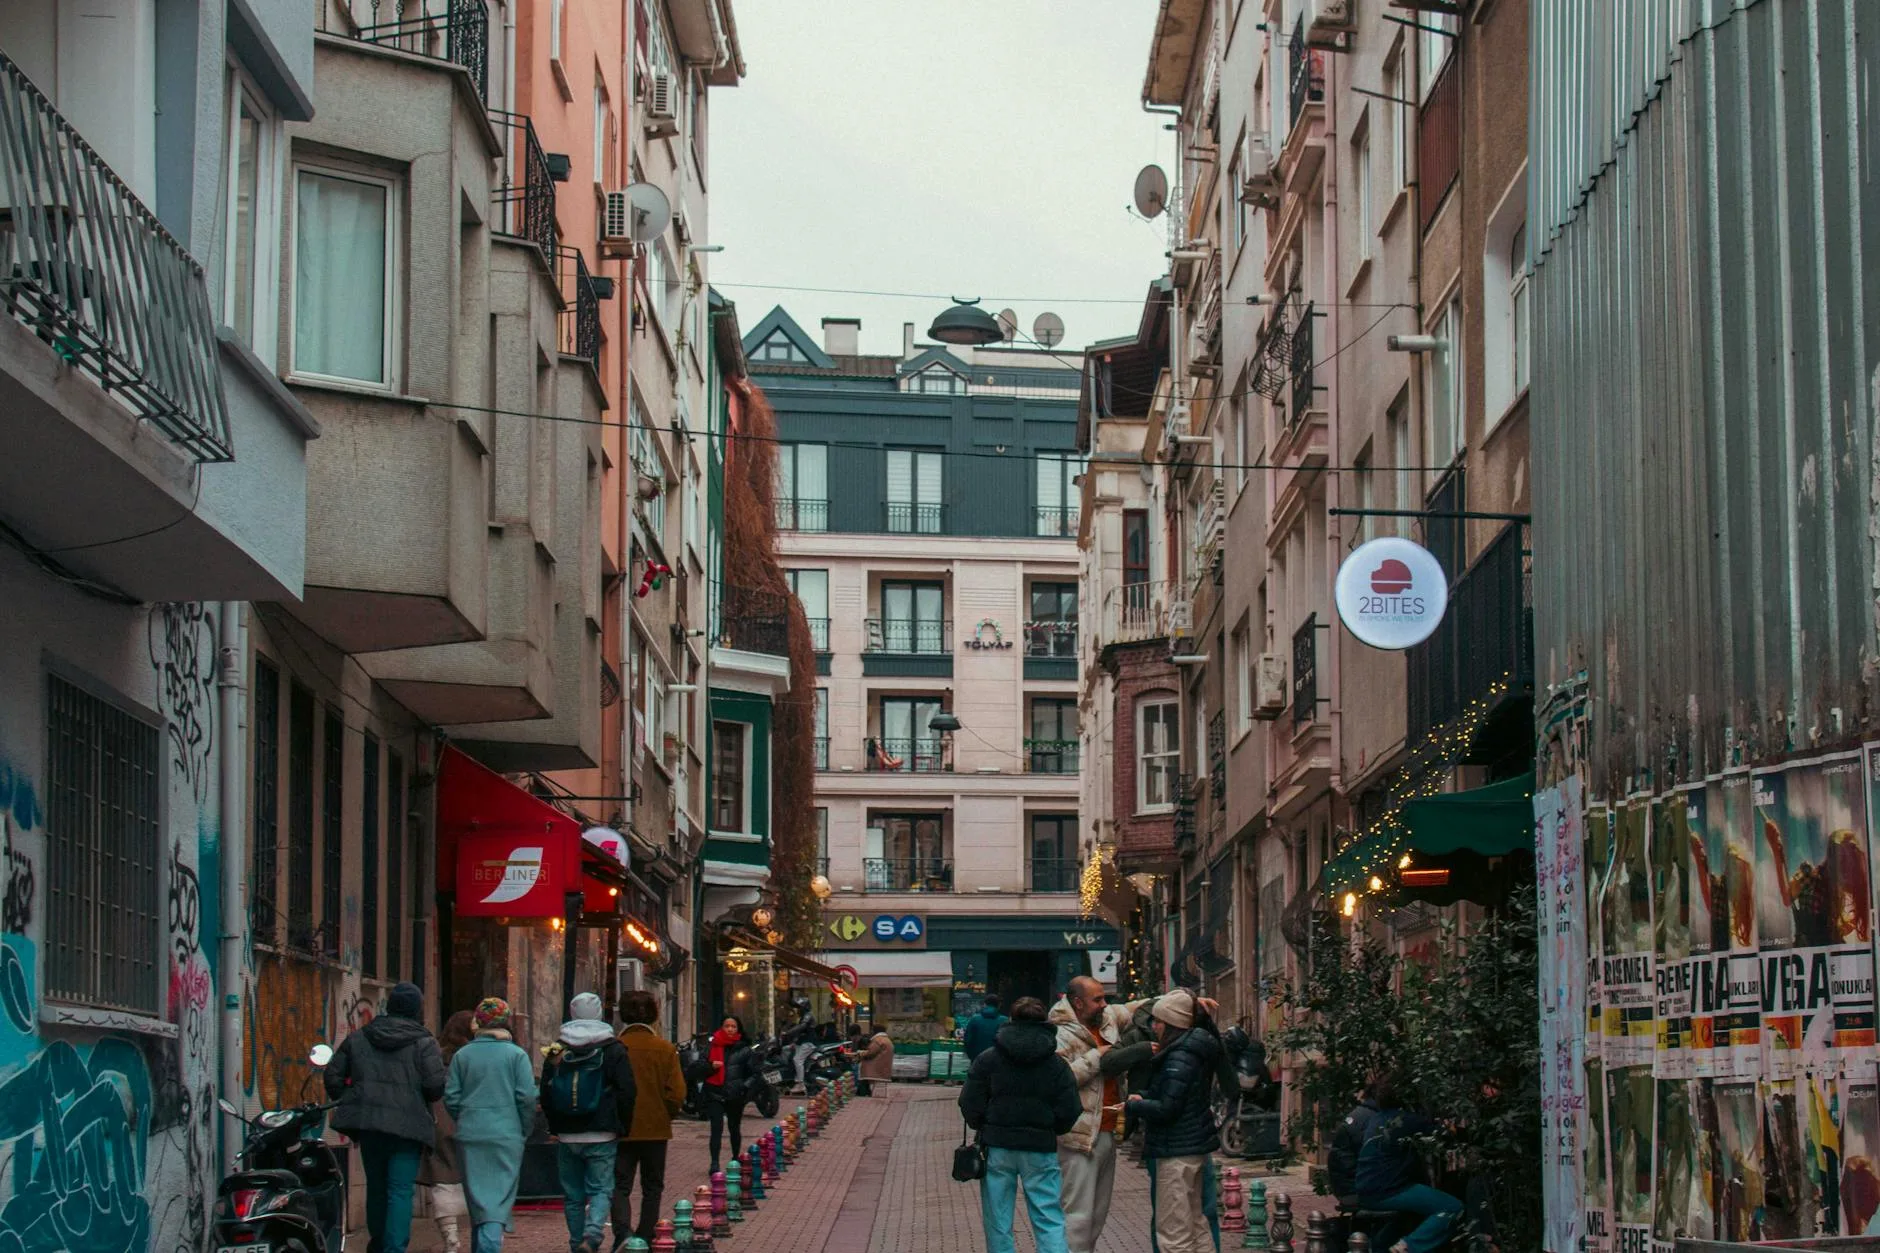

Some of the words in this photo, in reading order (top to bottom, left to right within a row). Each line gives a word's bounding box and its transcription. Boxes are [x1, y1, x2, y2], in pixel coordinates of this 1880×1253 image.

[1359, 596, 1425, 615] 2BITES
[475, 869, 547, 881] BERLINER
[877, 921, 920, 936] SA
